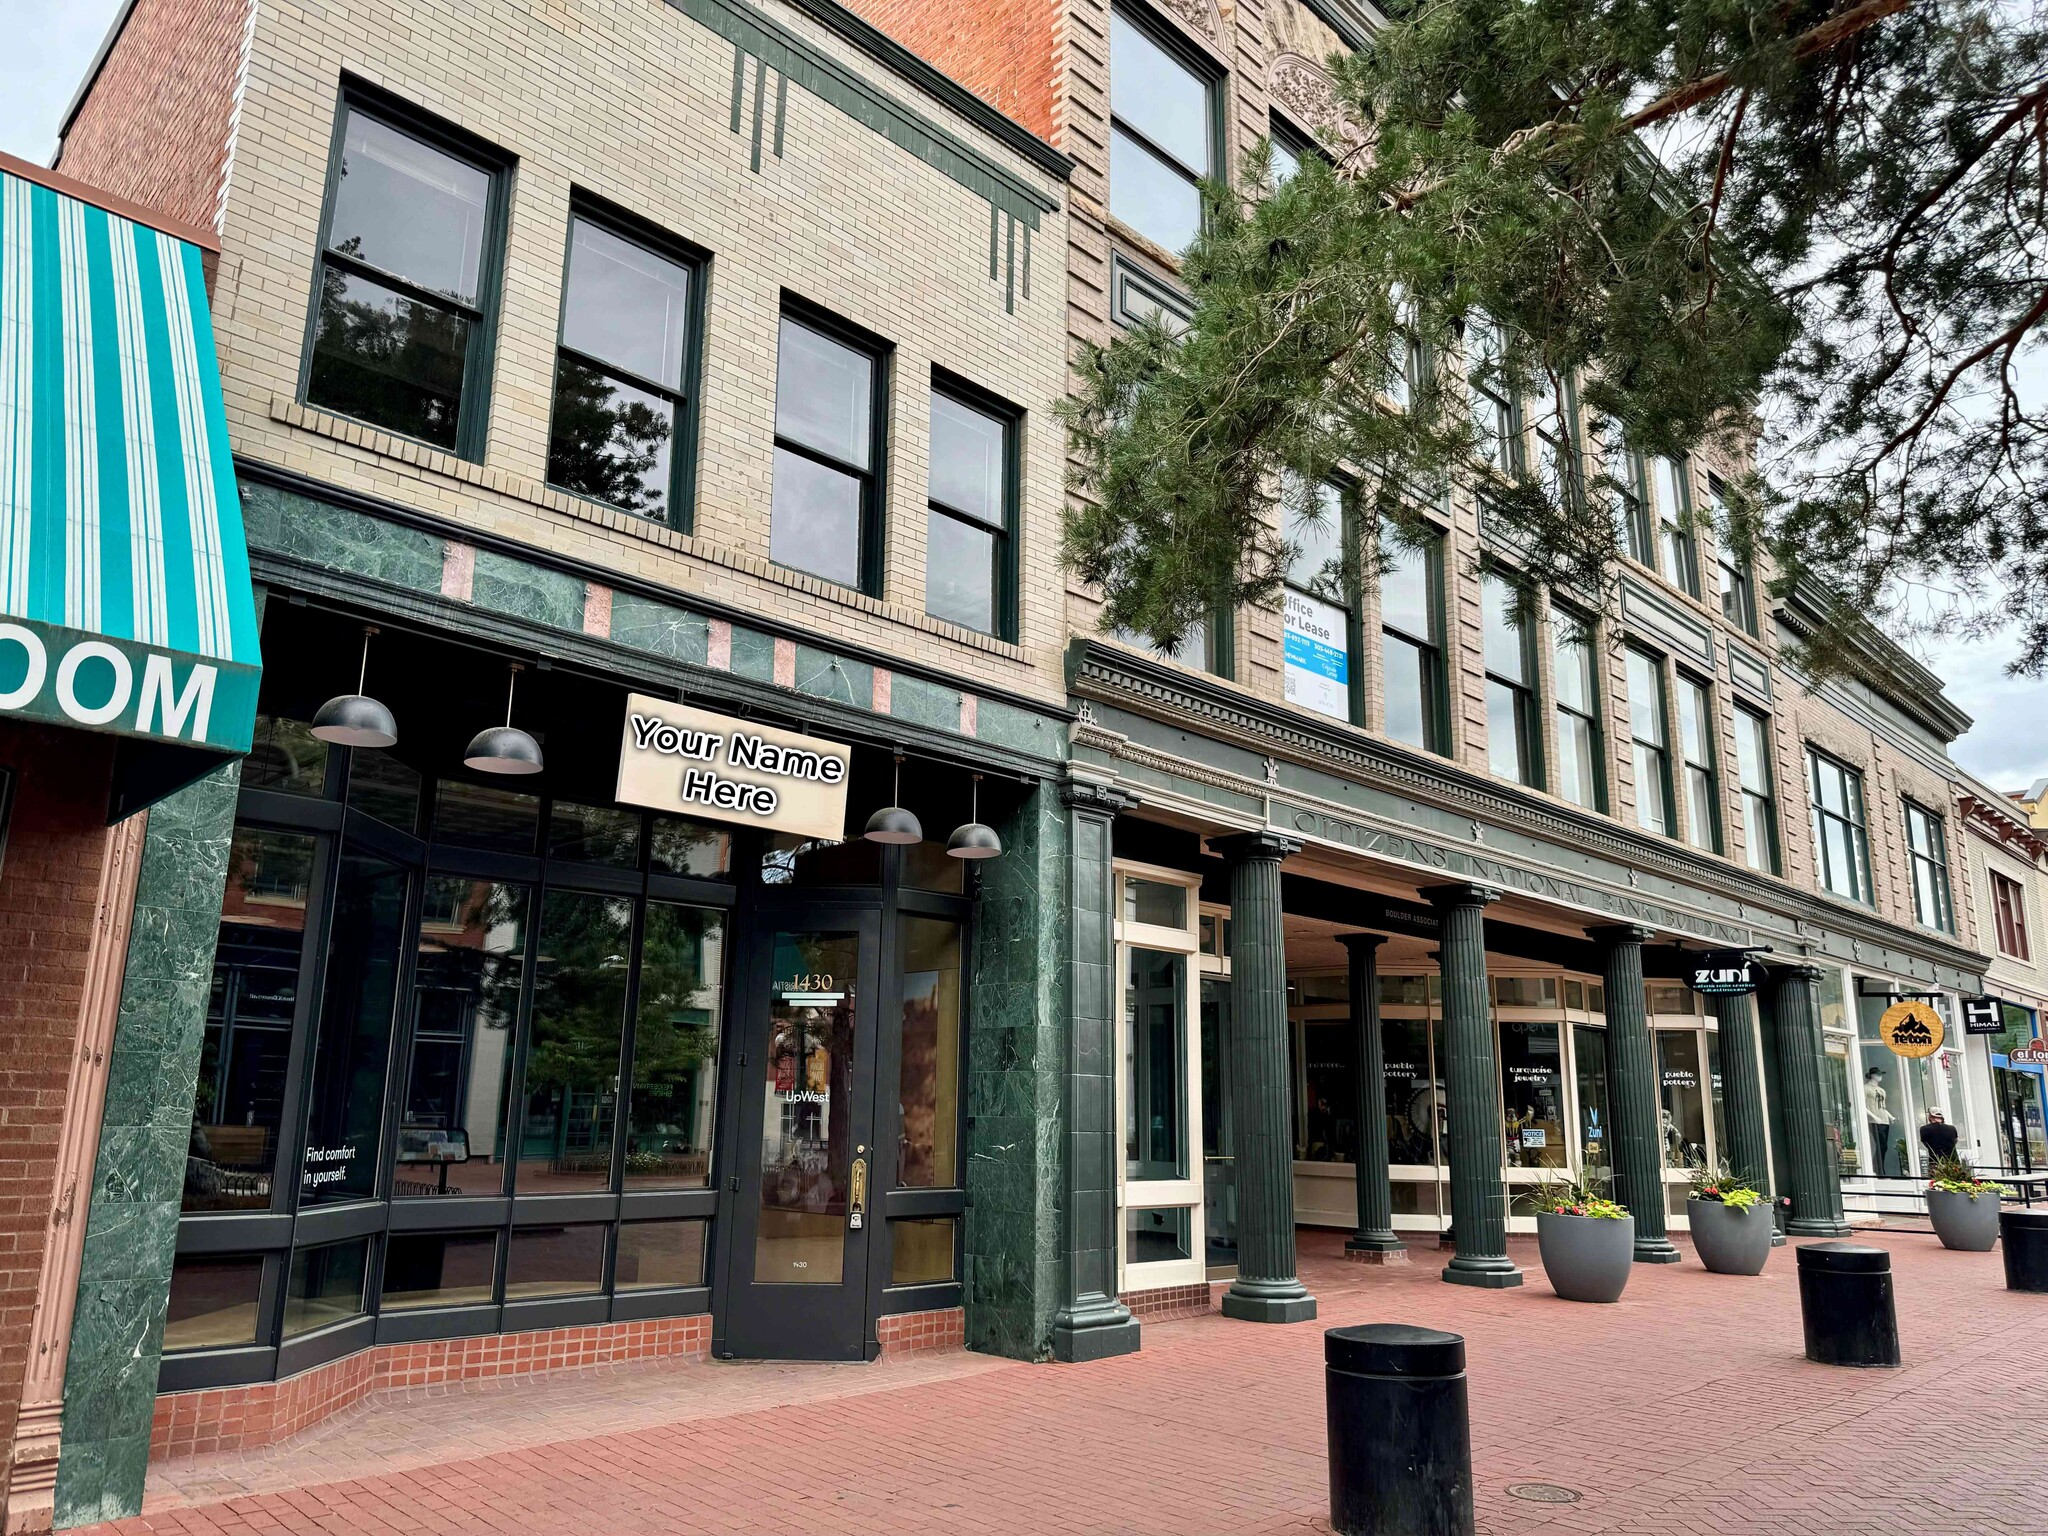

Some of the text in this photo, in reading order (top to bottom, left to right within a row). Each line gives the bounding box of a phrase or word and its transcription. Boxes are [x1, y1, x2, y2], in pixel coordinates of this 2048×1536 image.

[1284, 614, 1296, 626] or
[1299, 616, 1330, 640] Lease
[0, 623, 218, 742] OOM
[1293, 813, 1741, 943] CITIZENS NATIONAL BANK BUILDING
[1385, 909, 1412, 922] BOULDER
[1695, 961, 1751, 983] zuni
[793, 973, 833, 991] 1430
[1511, 1022, 1545, 1035] open
[2017, 1050, 2028, 1058] el
[1384, 1062, 1415, 1070] pueblo
[1509, 1065, 1552, 1075] turquoise
[1382, 1070, 1417, 1079] pottery
[1513, 1074, 1548, 1083] jewelry
[1665, 1071, 1694, 1079] pueblo
[1663, 1078, 1697, 1087] pottery
[786, 1090, 830, 1104] UpWest
[1587, 1126, 1602, 1138] Zuni
[306, 1145, 356, 1162] Find comfort
[303, 1166, 347, 1188] in yourself.
